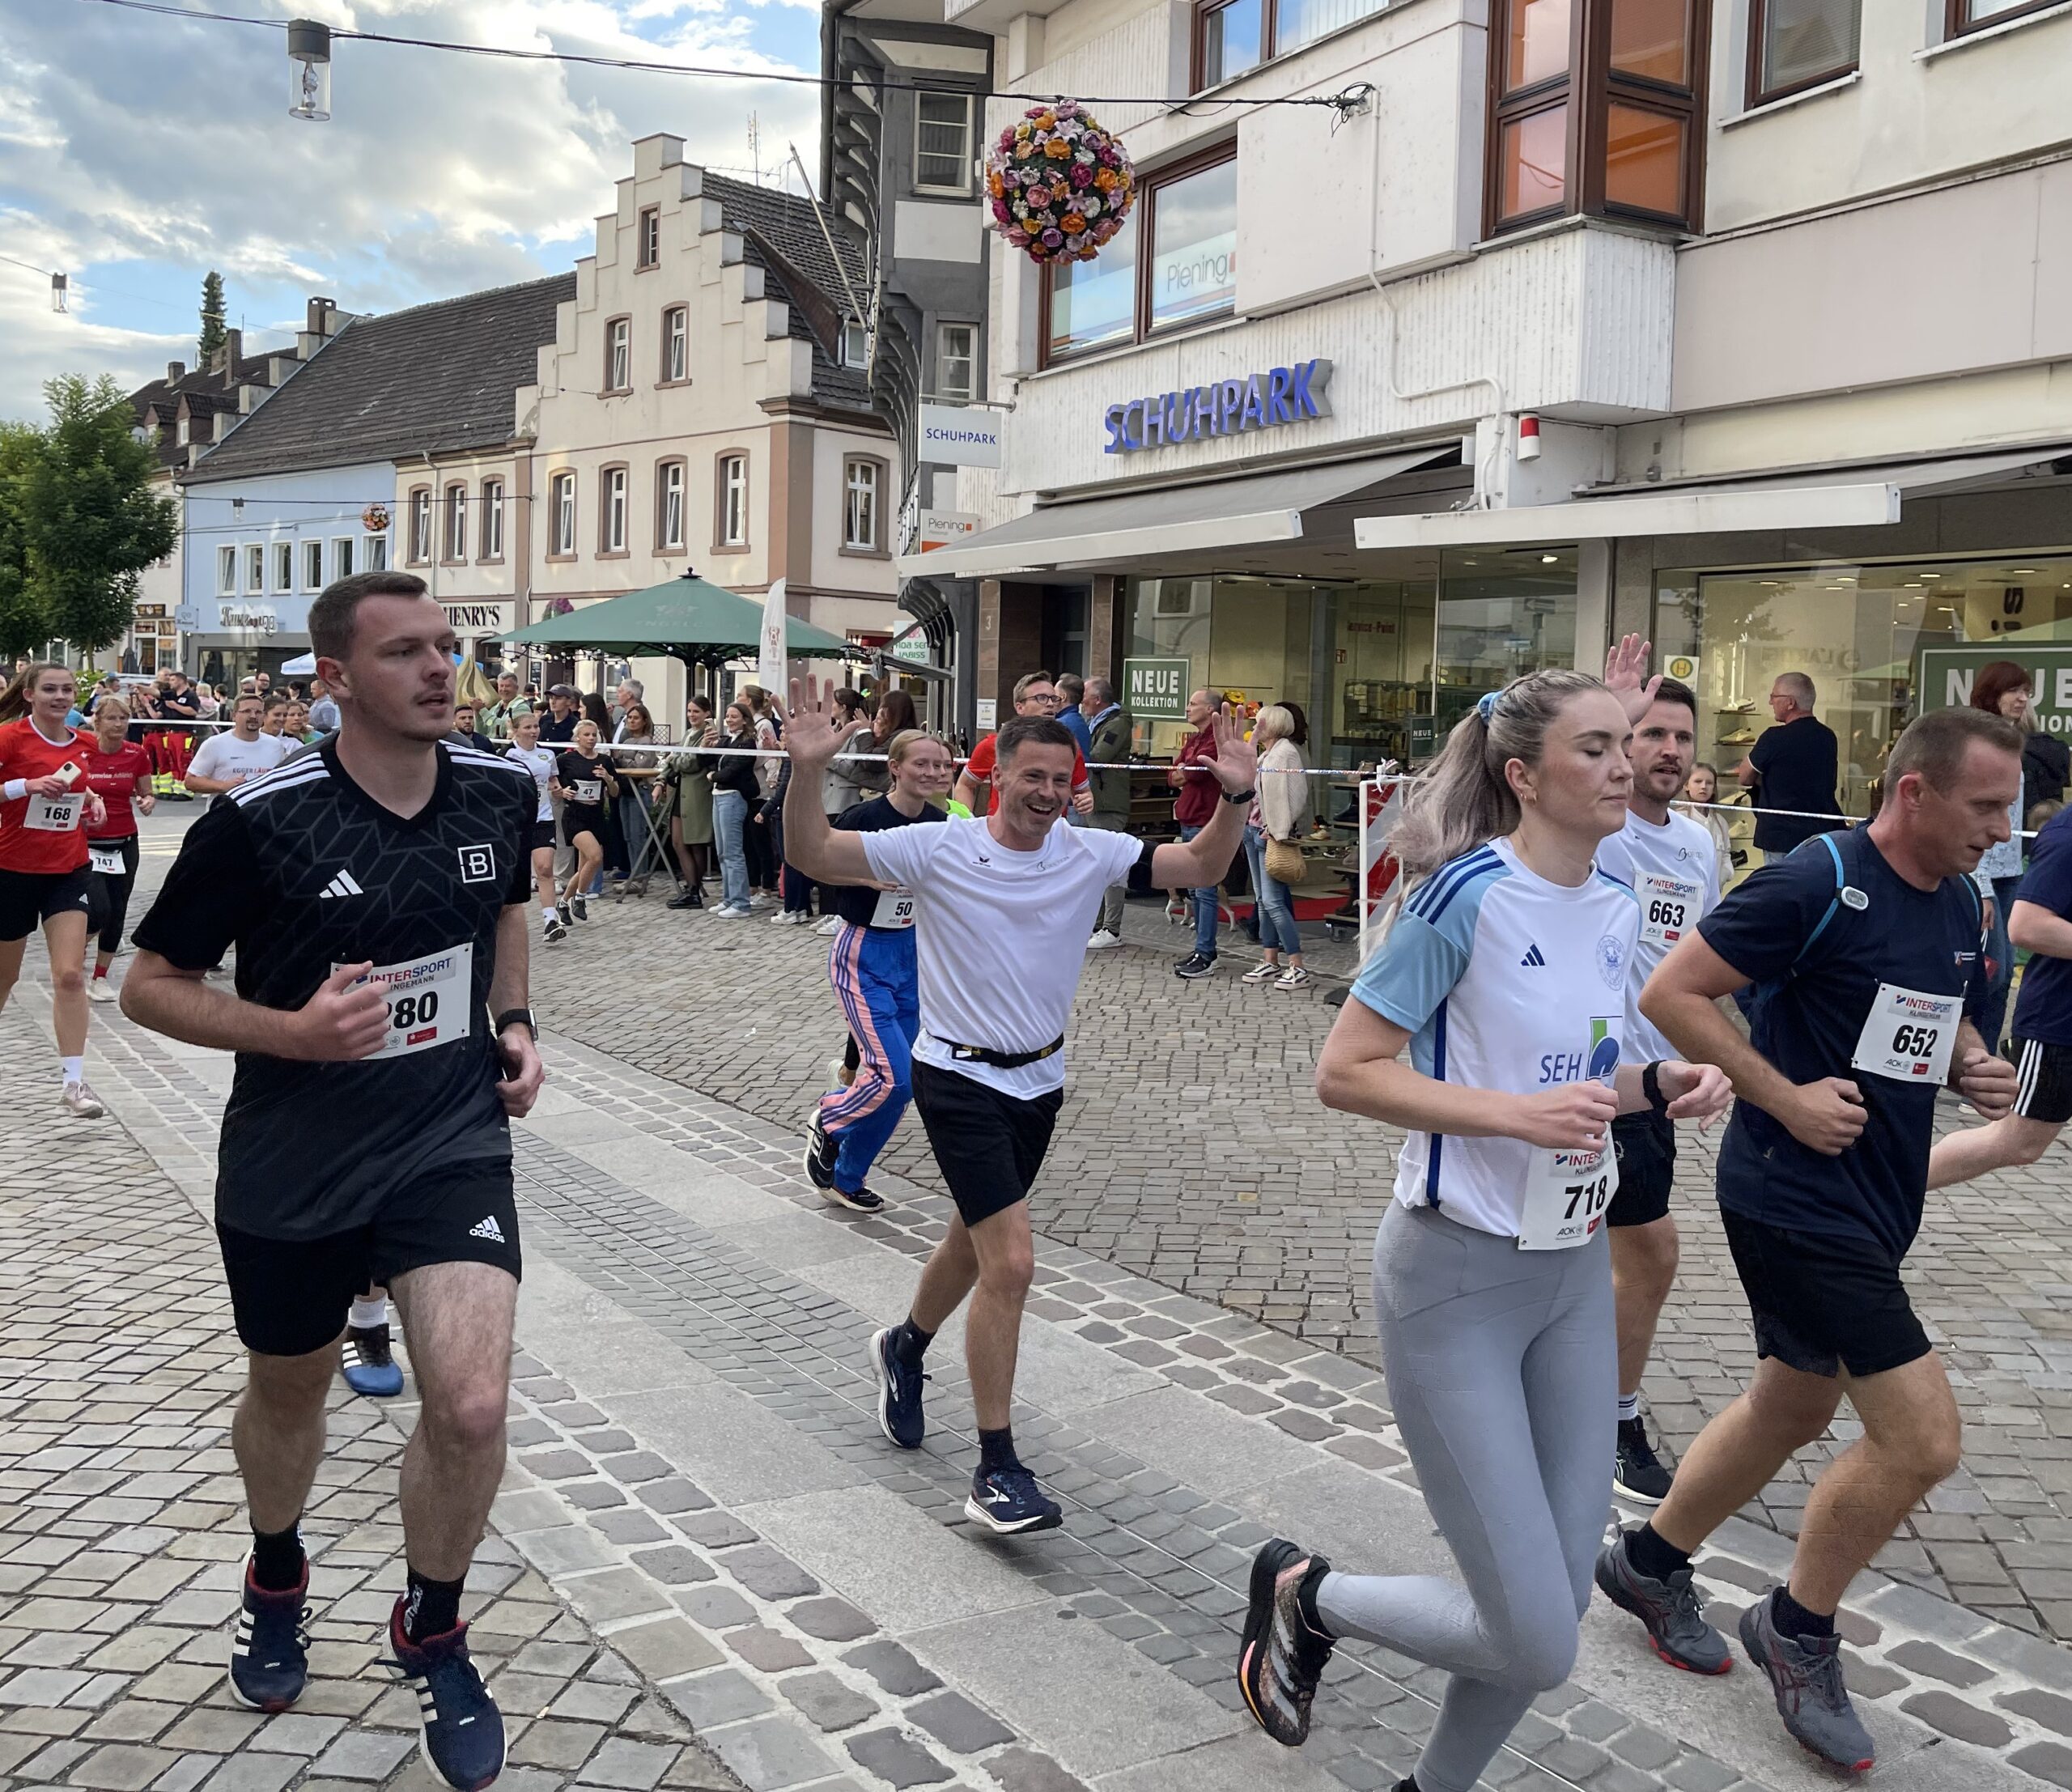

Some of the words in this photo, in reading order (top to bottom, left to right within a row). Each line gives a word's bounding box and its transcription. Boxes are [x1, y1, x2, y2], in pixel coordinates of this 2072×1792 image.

[1167, 253, 1228, 292] Piening
[1104, 359, 1318, 454] SCHUHPARK
[926, 427, 996, 444] SCHUHPARK
[928, 517, 965, 533] Piening
[985, 615, 992, 631] 3
[1132, 669, 1179, 694] NEUE
[1131, 696, 1178, 708] KOLLEKTION
[44, 806, 72, 821] 168
[96, 856, 113, 867] 747
[1653, 879, 1697, 894] INTERSPORT
[894, 901, 913, 916] 50
[1649, 899, 1685, 928] 663
[370, 957, 454, 984] INTERSPORT
[390, 974, 435, 992] INGEMANN
[387, 991, 439, 1030] 80
[1892, 1024, 1938, 1058] 652
[1539, 1052, 1583, 1084] SEH
[1884, 1058, 1903, 1068] AOK
[1564, 1174, 1607, 1220] 718
[469, 1228, 506, 1243] adidas
[1556, 1227, 1576, 1237] AOK
